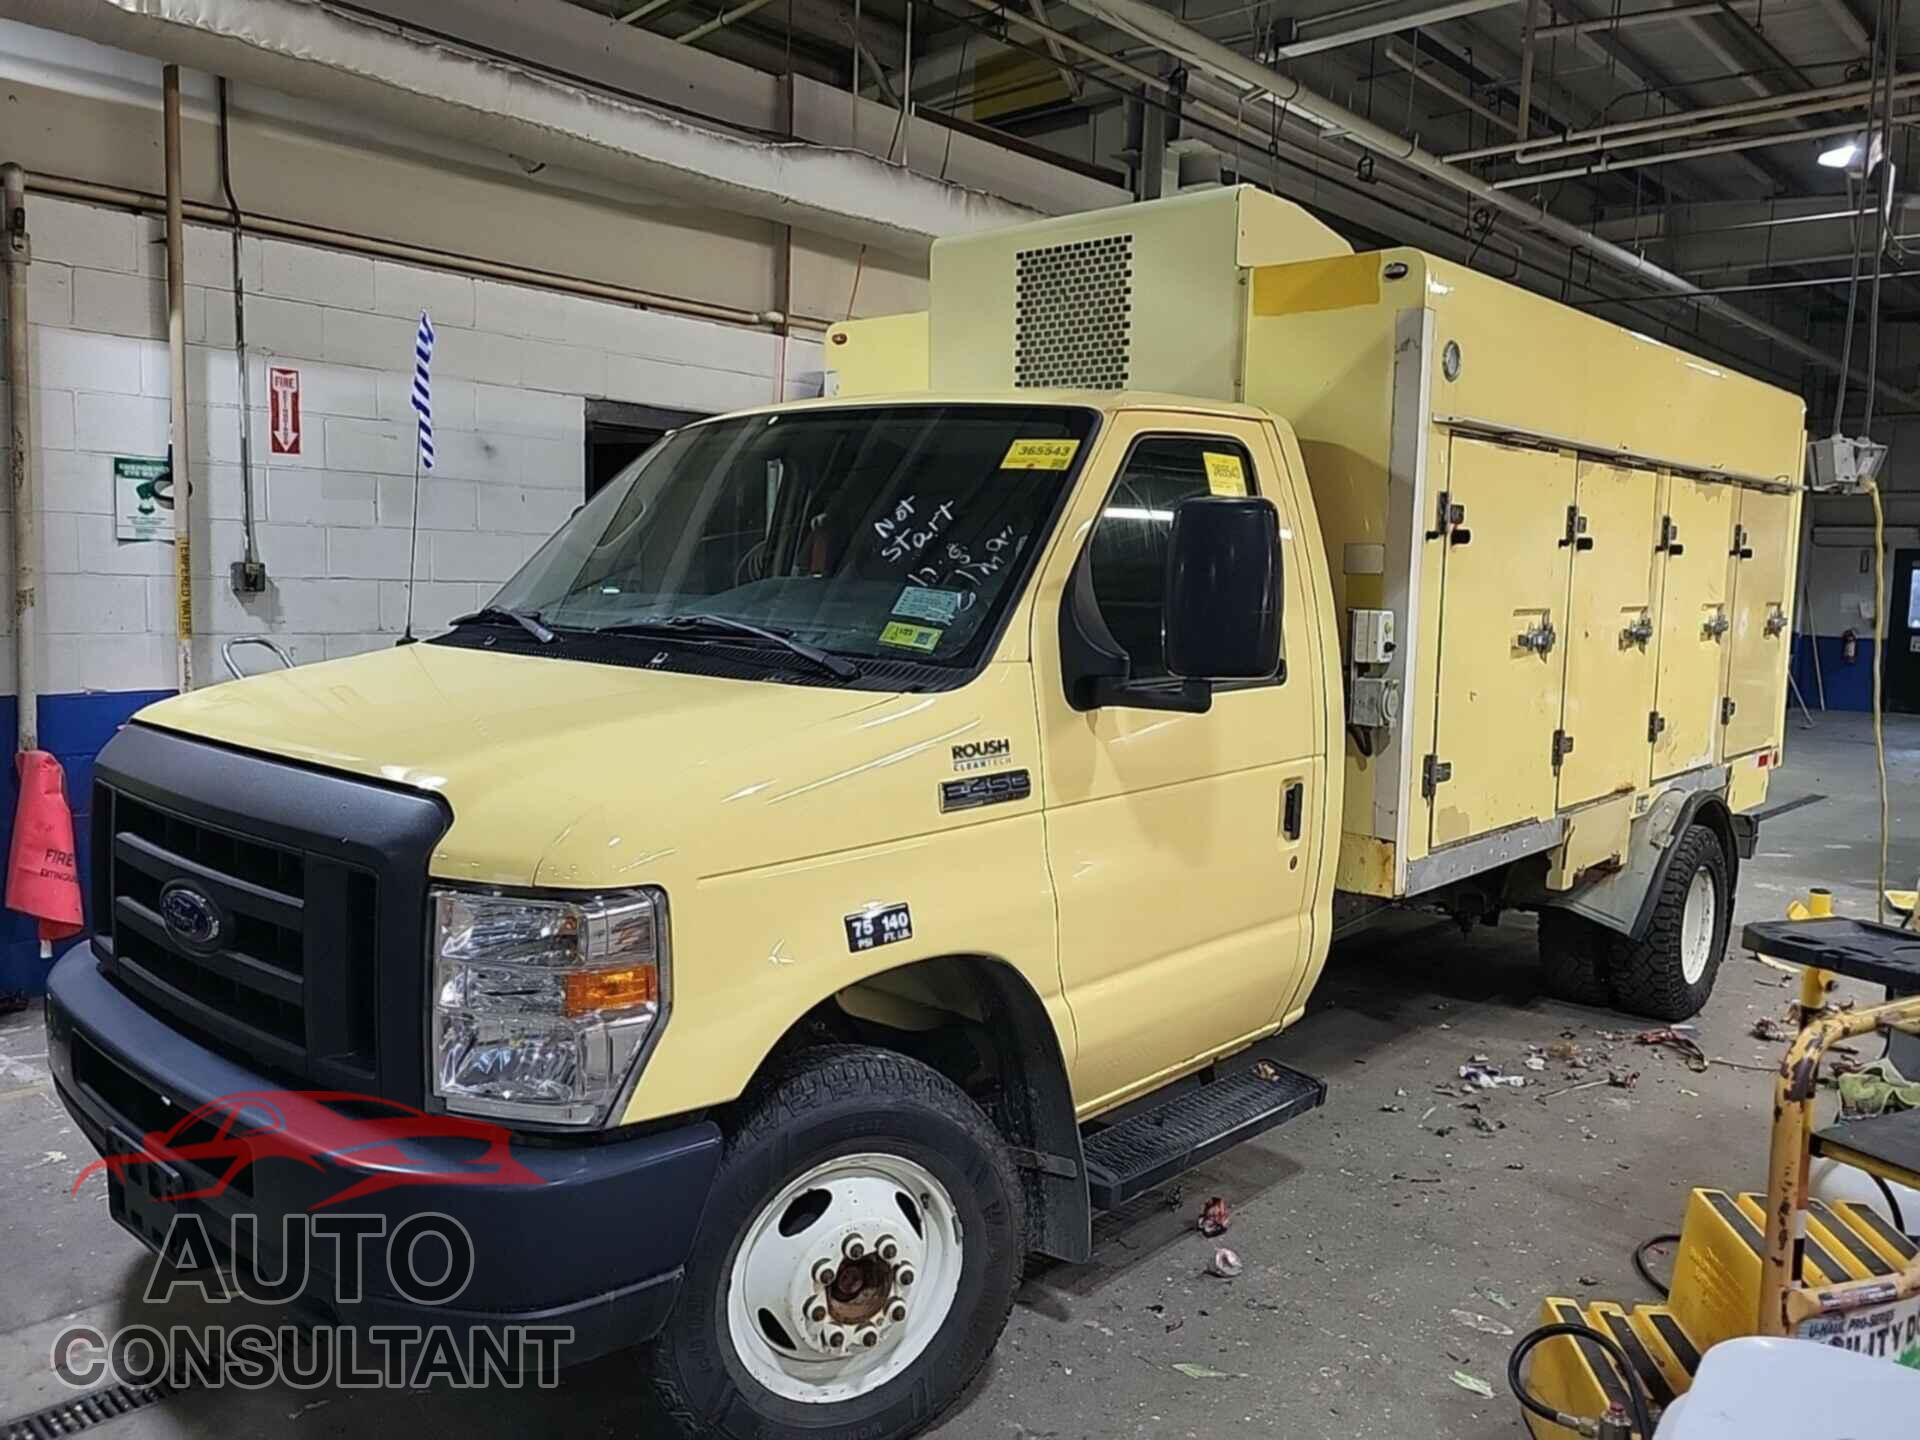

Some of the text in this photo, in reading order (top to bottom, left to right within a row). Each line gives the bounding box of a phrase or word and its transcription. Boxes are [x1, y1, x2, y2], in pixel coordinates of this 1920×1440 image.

[274, 376, 296, 389] FIRE
[180, 538, 192, 638] TEMPERED WATER
[951, 738, 1010, 760] ROUSH
[953, 757, 1012, 772] CLEANTECH
[44, 849, 73, 868] FIRE
[851, 911, 909, 938] 75 140
[857, 938, 874, 949] PSI
[1808, 1308, 1895, 1339] U-HAUL PRO-SERIES
